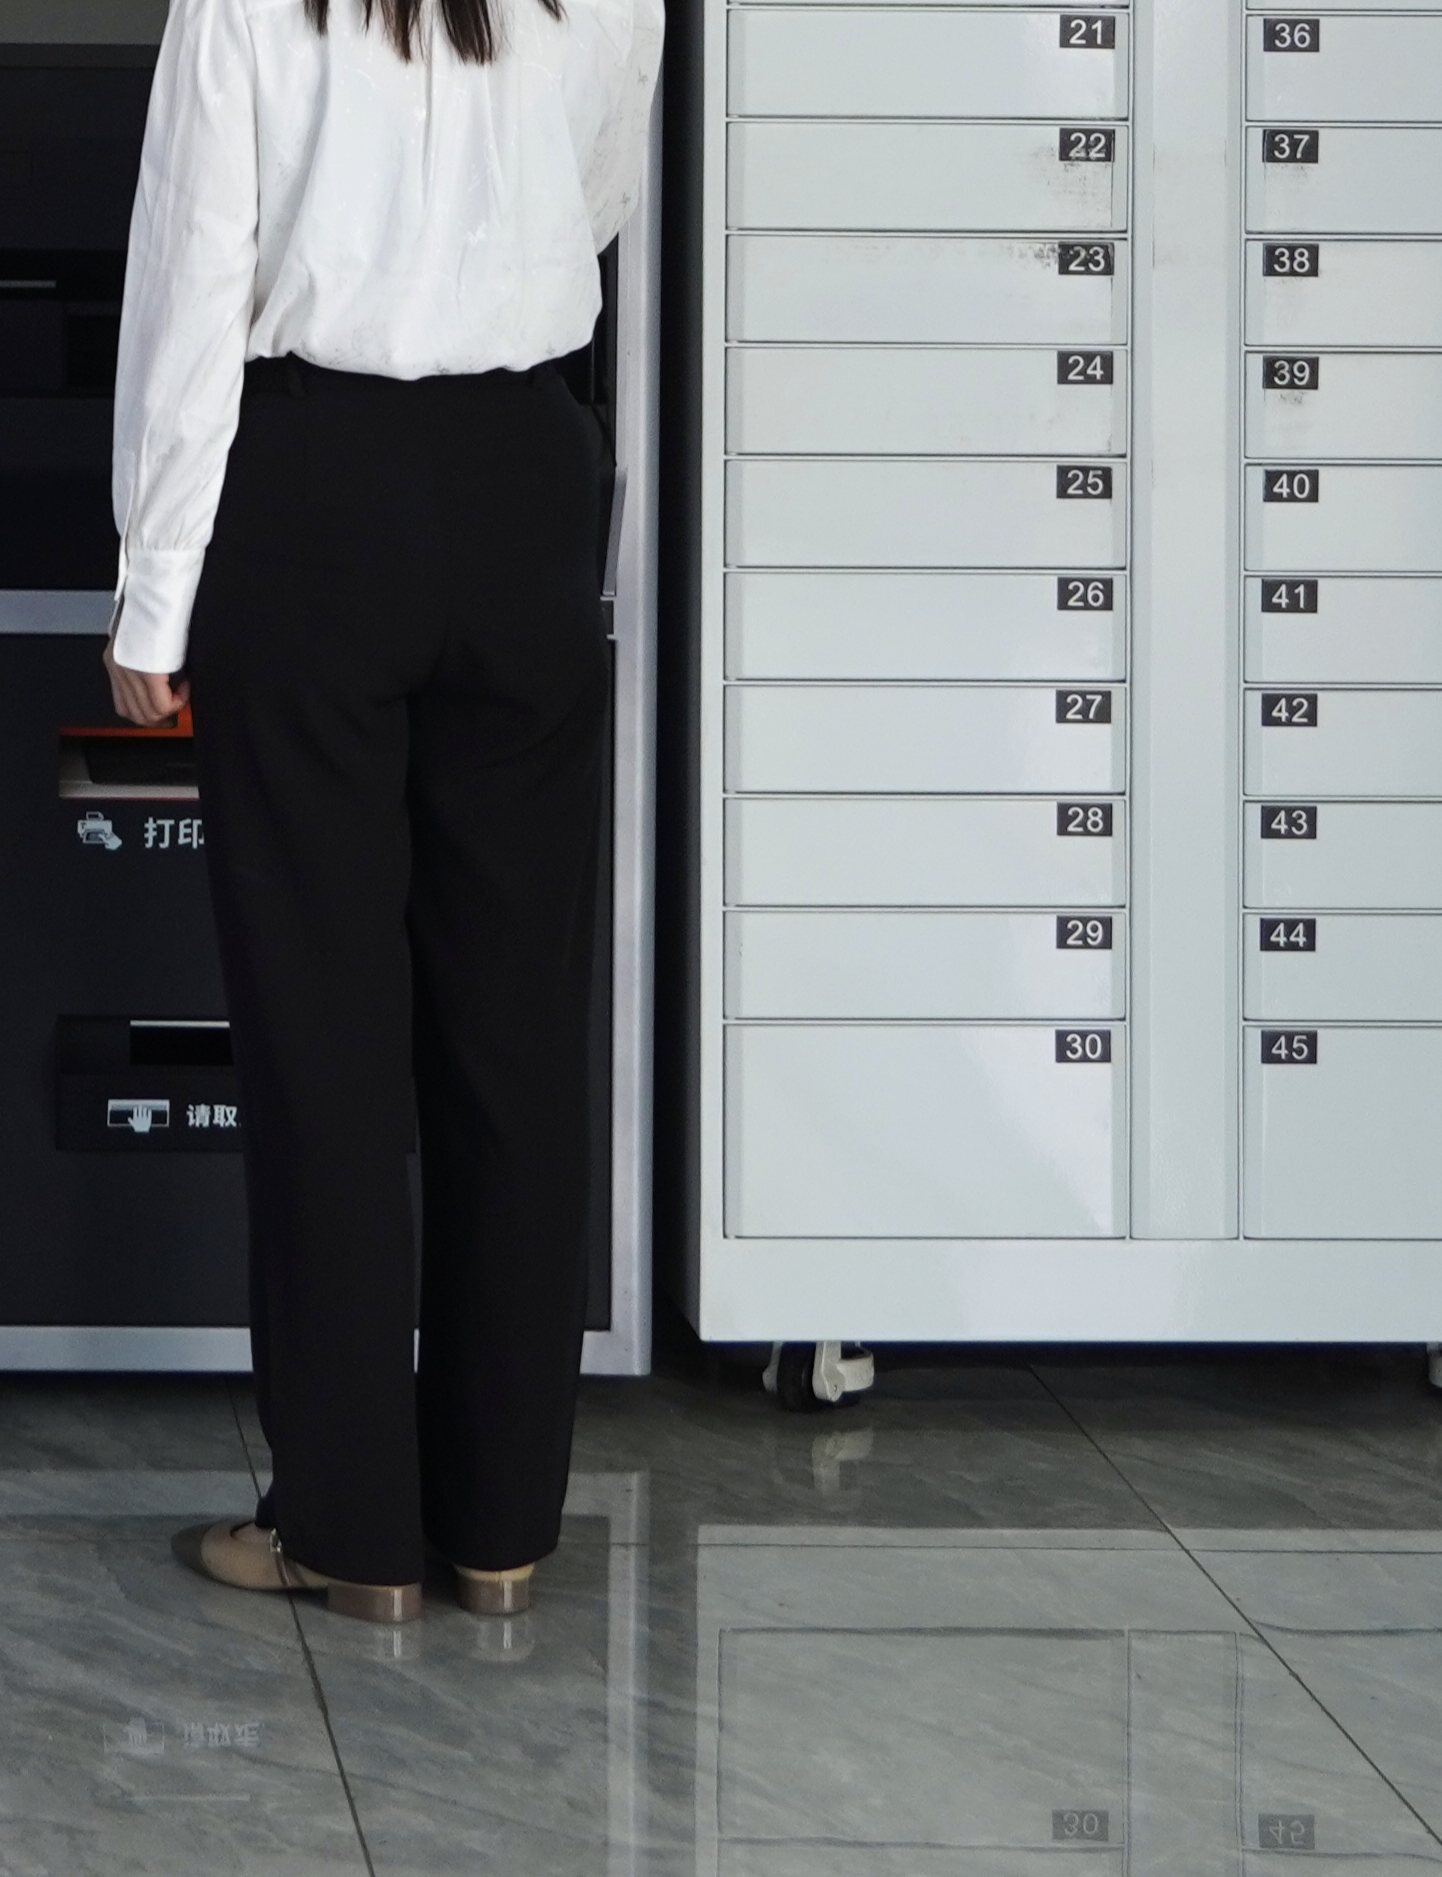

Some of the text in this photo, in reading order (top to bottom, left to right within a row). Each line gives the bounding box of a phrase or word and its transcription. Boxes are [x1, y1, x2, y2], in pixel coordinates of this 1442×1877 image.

[1069, 19, 1102, 45] 21
[1274, 22, 1311, 48] 36
[1068, 132, 1106, 159] 22
[1273, 133, 1310, 159] 37
[1068, 246, 1105, 272] 23
[1273, 247, 1310, 273] 38
[1067, 355, 1104, 381] 24
[1273, 360, 1310, 386] 39
[1066, 469, 1104, 496] 25
[1272, 473, 1310, 499] 40
[1067, 581, 1104, 607] 26
[1271, 583, 1305, 609] 41
[1065, 694, 1103, 720] 27
[1271, 697, 1309, 723] 42
[1066, 806, 1104, 833] 28
[1270, 809, 1308, 836] 43
[143, 818, 205, 849] 打印
[1066, 919, 1103, 946] 29
[1269, 922, 1307, 947] 44
[1066, 1033, 1102, 1060] 30
[1271, 1035, 1309, 1060] 45
